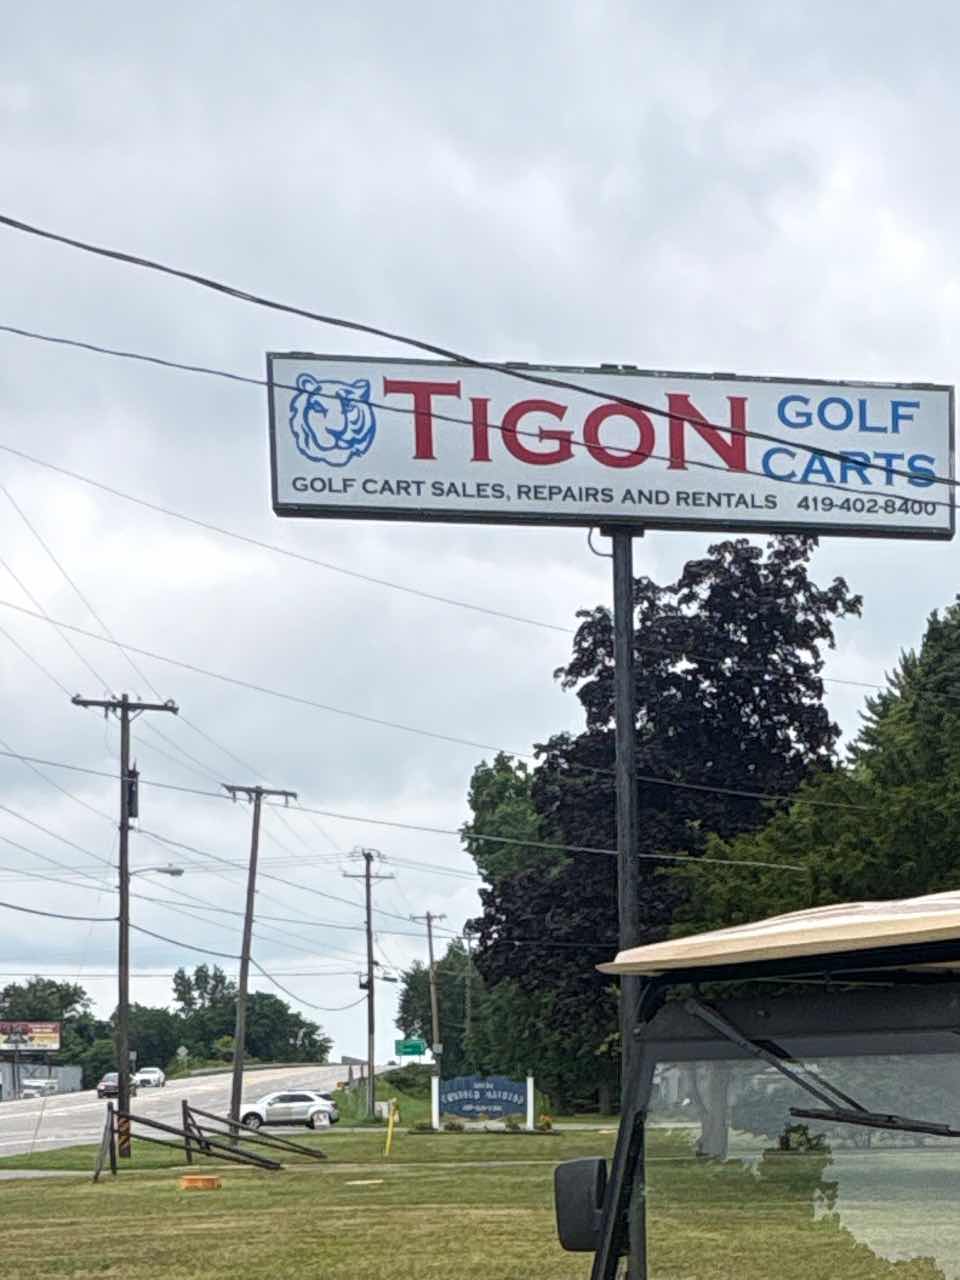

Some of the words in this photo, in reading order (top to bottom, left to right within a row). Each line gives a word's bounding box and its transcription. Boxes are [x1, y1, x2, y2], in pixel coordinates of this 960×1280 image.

[383, 376, 748, 473] TIGON
[777, 394, 921, 434] GOLF
[762, 447, 937, 488] CARTS
[292, 476, 357, 494] GOLF
[362, 478, 426, 497] CART
[432, 481, 511, 501] SALES,
[517, 484, 614, 503] REPAIRS
[621, 488, 670, 506] AND
[676, 491, 777, 510] RENTALS
[797, 495, 937, 516] 419-402-8400
